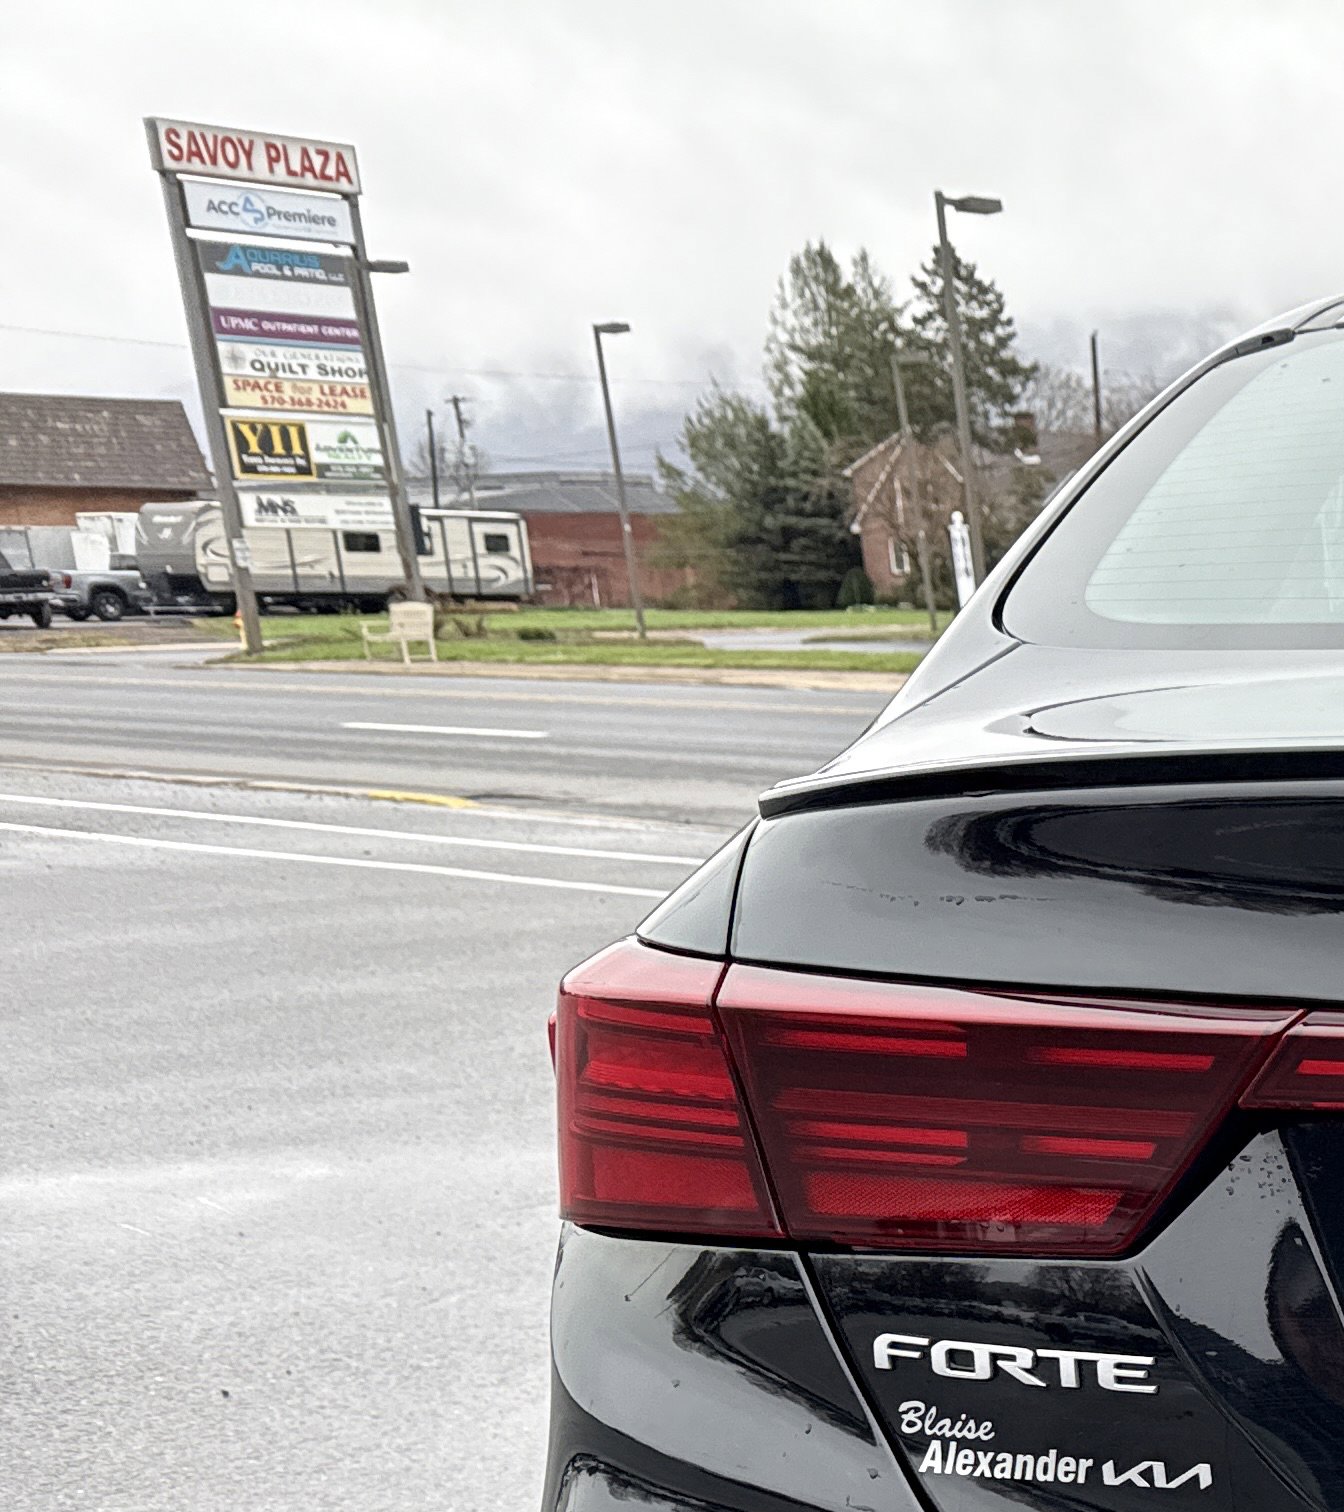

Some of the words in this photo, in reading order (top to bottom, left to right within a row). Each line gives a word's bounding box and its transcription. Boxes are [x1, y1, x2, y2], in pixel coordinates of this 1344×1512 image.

[164, 127, 254, 172] SAVOY
[264, 141, 354, 185] PLAZA
[206, 199, 240, 216] ACC
[266, 206, 337, 227] Premiere
[251, 262, 282, 276] POOL
[219, 315, 259, 332] UPMC
[261, 320, 319, 335] OUTPATIENT
[250, 359, 309, 376] QUILT
[233, 379, 284, 394] SPACE
[291, 382, 313, 396] for
[319, 383, 367, 399] LEASE
[872, 1332, 1160, 1395] FORTE
[898, 1400, 996, 1441] Blaise
[919, 1439, 1094, 1485] Alexander
